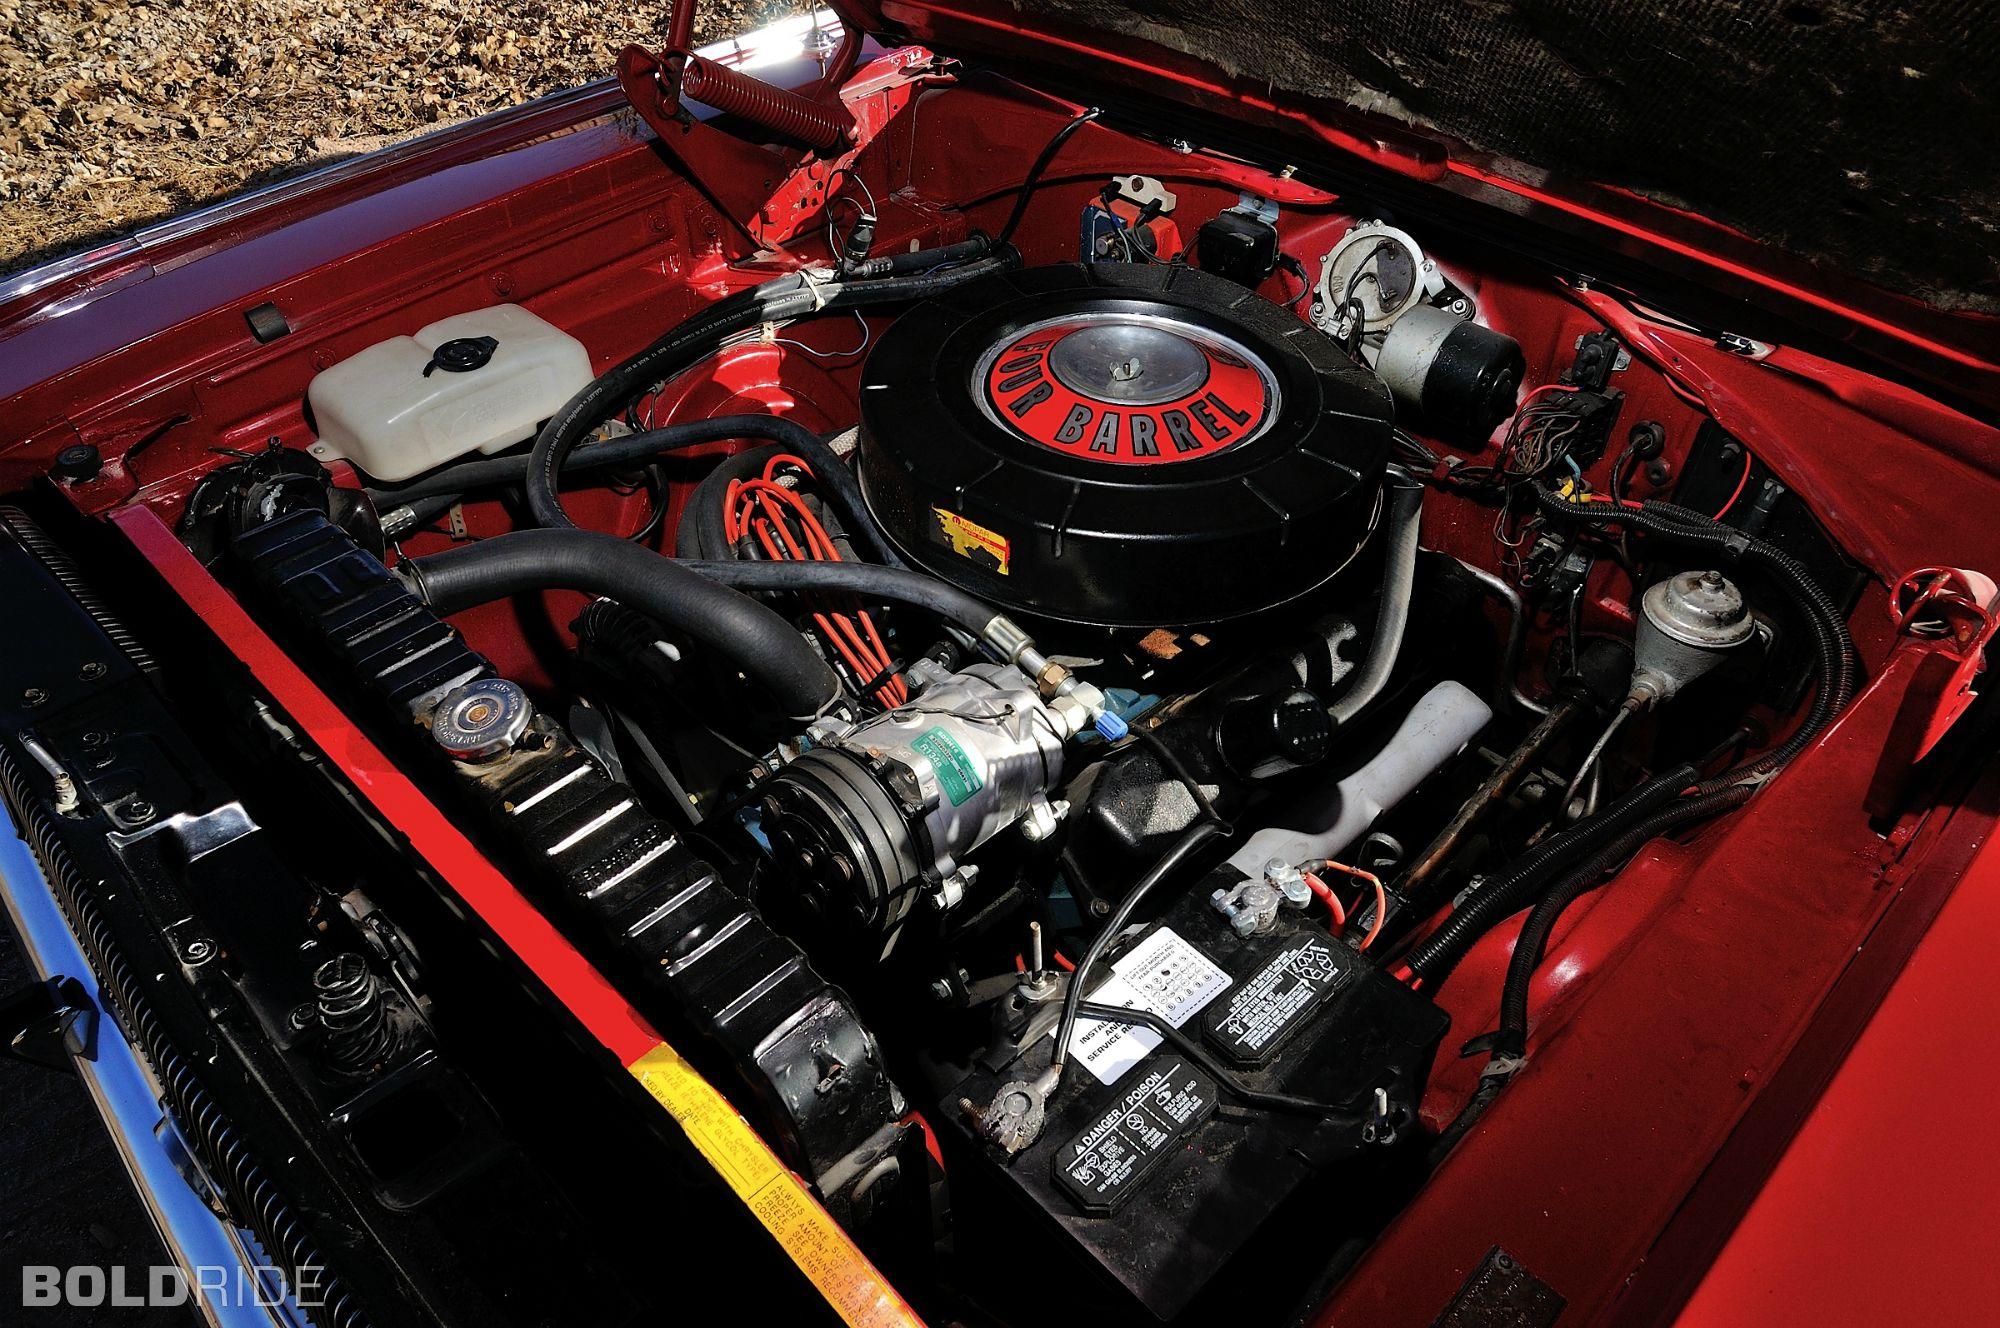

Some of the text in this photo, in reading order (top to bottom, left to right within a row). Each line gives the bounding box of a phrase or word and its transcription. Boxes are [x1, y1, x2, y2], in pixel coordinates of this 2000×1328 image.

[998, 340, 1252, 456] FOUR BARREL
[962, 520, 990, 538] MOPAR
[1104, 1019, 1123, 1036] AND
[1087, 1032, 1121, 1062] SERVICE
[654, 1088, 666, 1099] BY
[662, 1097, 687, 1122] DEALER
[1081, 1108, 1122, 1146] DANGER
[1124, 1071, 1162, 1105] POISON
[1162, 1079, 1197, 1112] SULFURIC ACID
[682, 1106, 702, 1126] DATE
[1138, 1125, 1149, 1135] NO
[712, 1127, 741, 1156] GLYCOL
[715, 1116, 735, 1136] WITH
[733, 1136, 770, 1174] CHRYSLER
[1097, 1134, 1118, 1153] SHIELD
[1103, 1143, 1118, 1158] EYES
[1097, 1145, 1125, 1172] EXPLOSIVE
[1102, 1159, 1122, 1177] GASES
[761, 1195, 789, 1225] FREEZE
[791, 1230, 808, 1246] SEE
[768, 1189, 797, 1220] PROPER
[796, 1222, 828, 1255] AMOUNT
[829, 1258, 842, 1271] OF
[775, 1184, 805, 1215] ALWAYS
[805, 1218, 830, 1242] MAKE
[830, 1245, 853, 1268] SURE
[753, 1201, 785, 1235] COOLING
[784, 1237, 819, 1274] SYSTEMS
